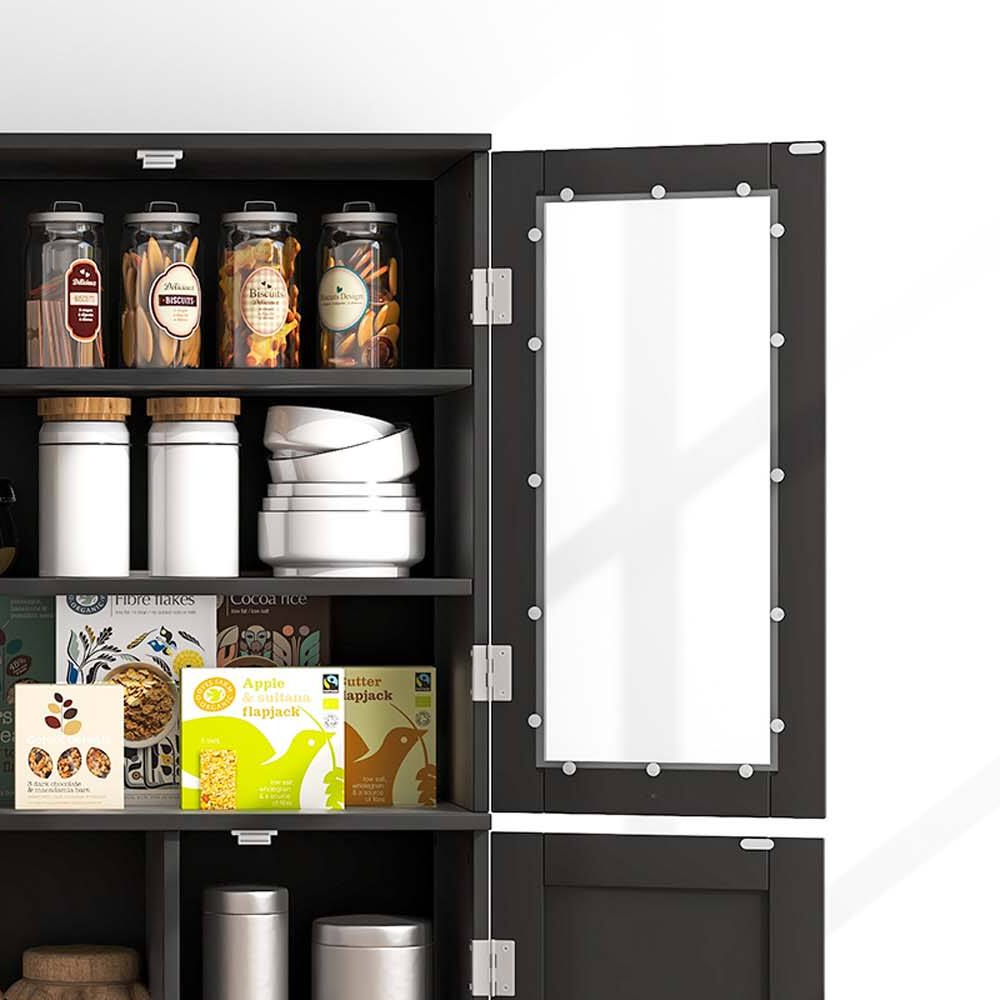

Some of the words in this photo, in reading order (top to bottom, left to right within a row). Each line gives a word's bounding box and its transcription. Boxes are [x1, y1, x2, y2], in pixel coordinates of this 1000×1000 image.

[249, 288, 284, 299] Biscuits
[165, 296, 194, 304] BISCUITS
[115, 595, 150, 606] Fibre
[230, 595, 277, 605] Cocoa
[281, 595, 308, 605] rice
[242, 677, 285, 692] Apple
[242, 706, 300, 720] flapjack
